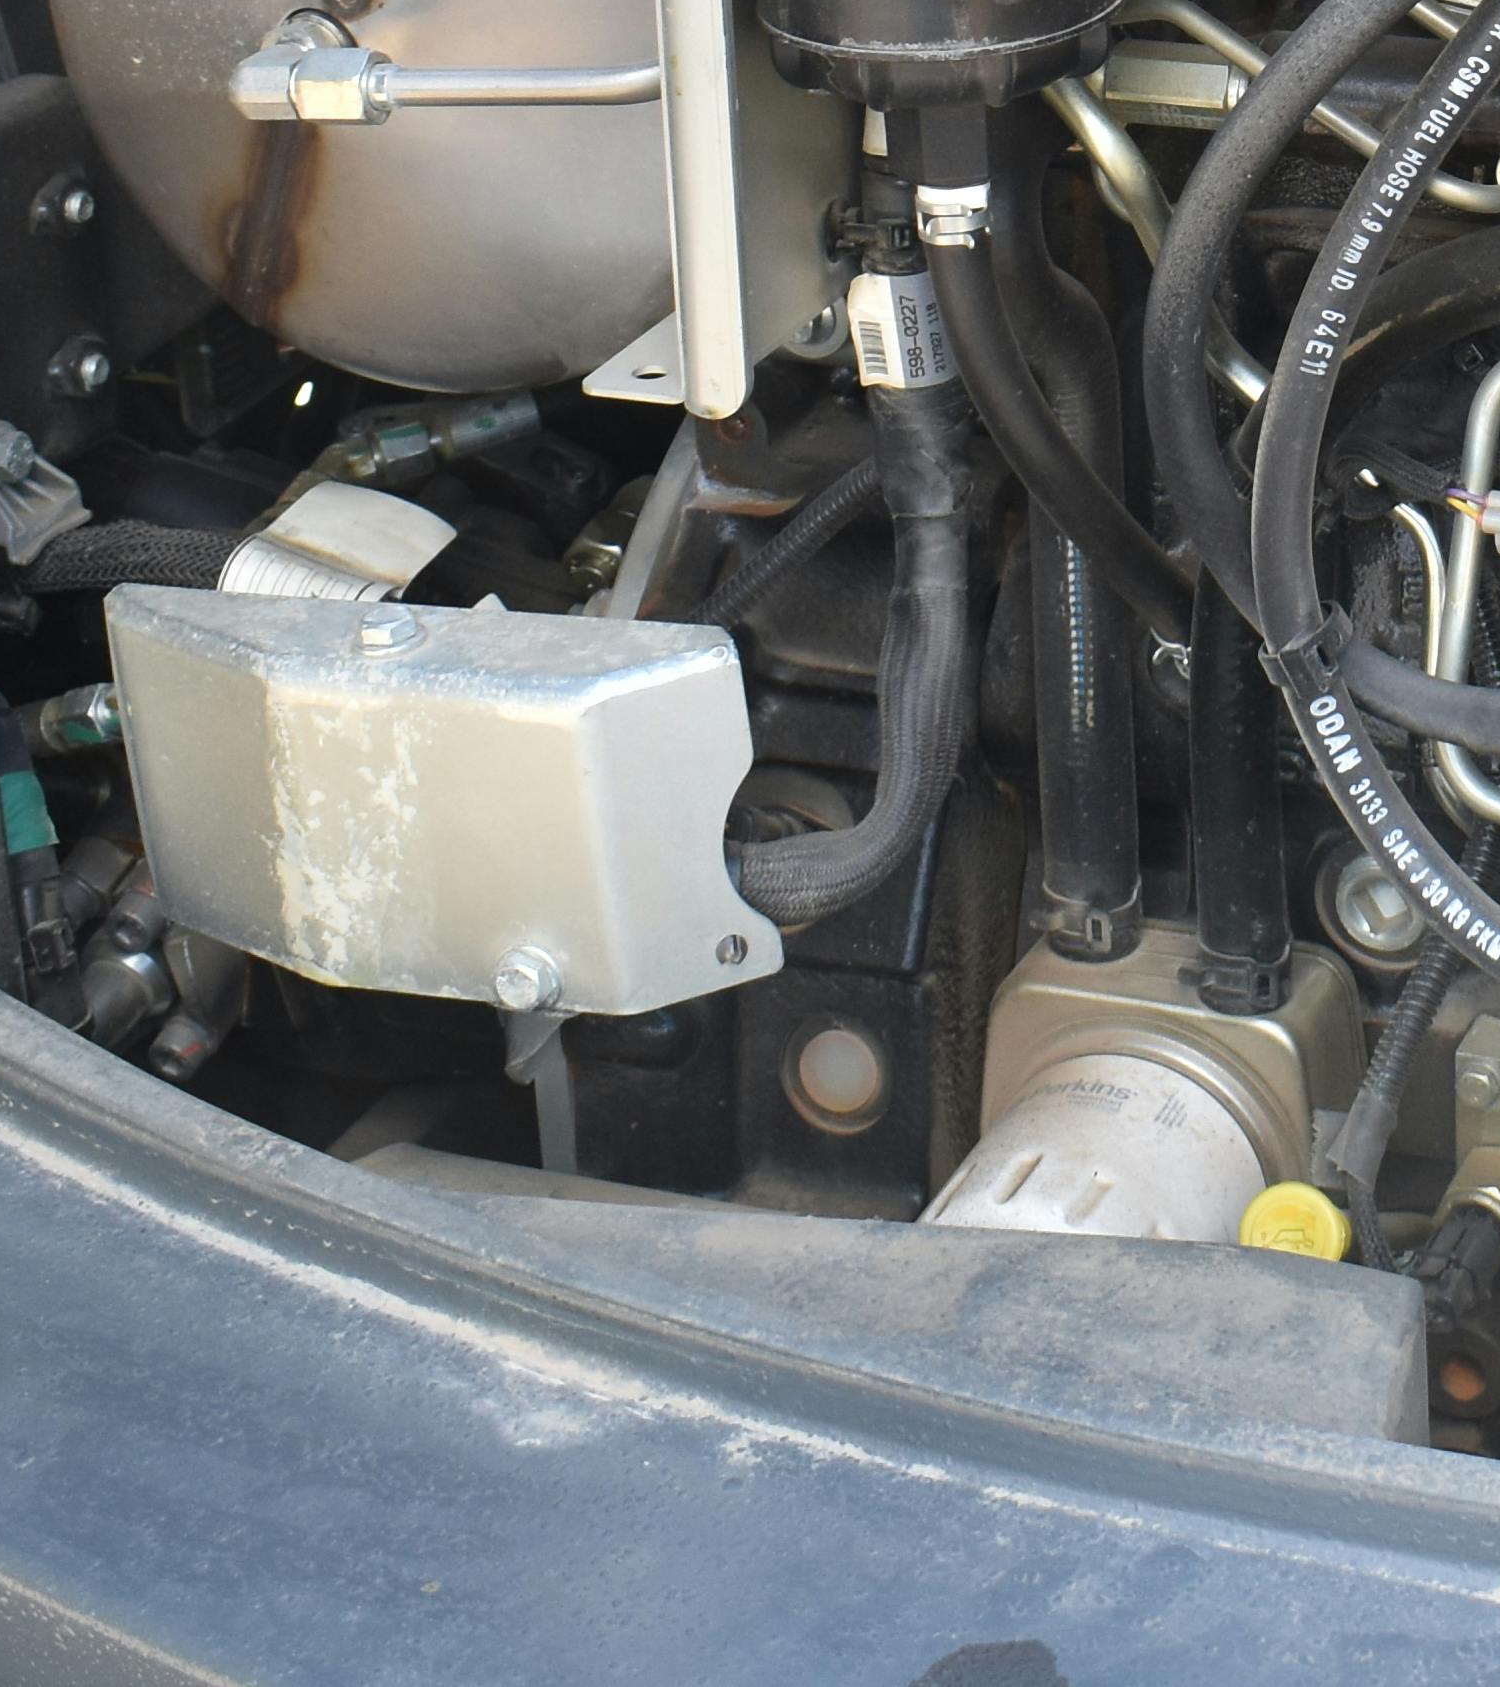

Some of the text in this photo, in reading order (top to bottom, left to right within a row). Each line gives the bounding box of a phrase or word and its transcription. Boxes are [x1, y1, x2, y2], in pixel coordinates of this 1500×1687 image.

[1448, 56, 1491, 99] CSM
[1414, 97, 1460, 144] FUEL
[1379, 147, 1427, 201] HOSE
[1361, 202, 1393, 233] 7.9
[1343, 233, 1370, 264] mm
[898, 295, 926, 379] 598-0227
[1309, 695, 1363, 774] ODAN
[1349, 778, 1389, 825] 3133
[1382, 828, 1419, 871] SAE
[1409, 867, 1431, 884] J
[1421, 878, 1449, 908] 30
[1442, 898, 1471, 930] R9
